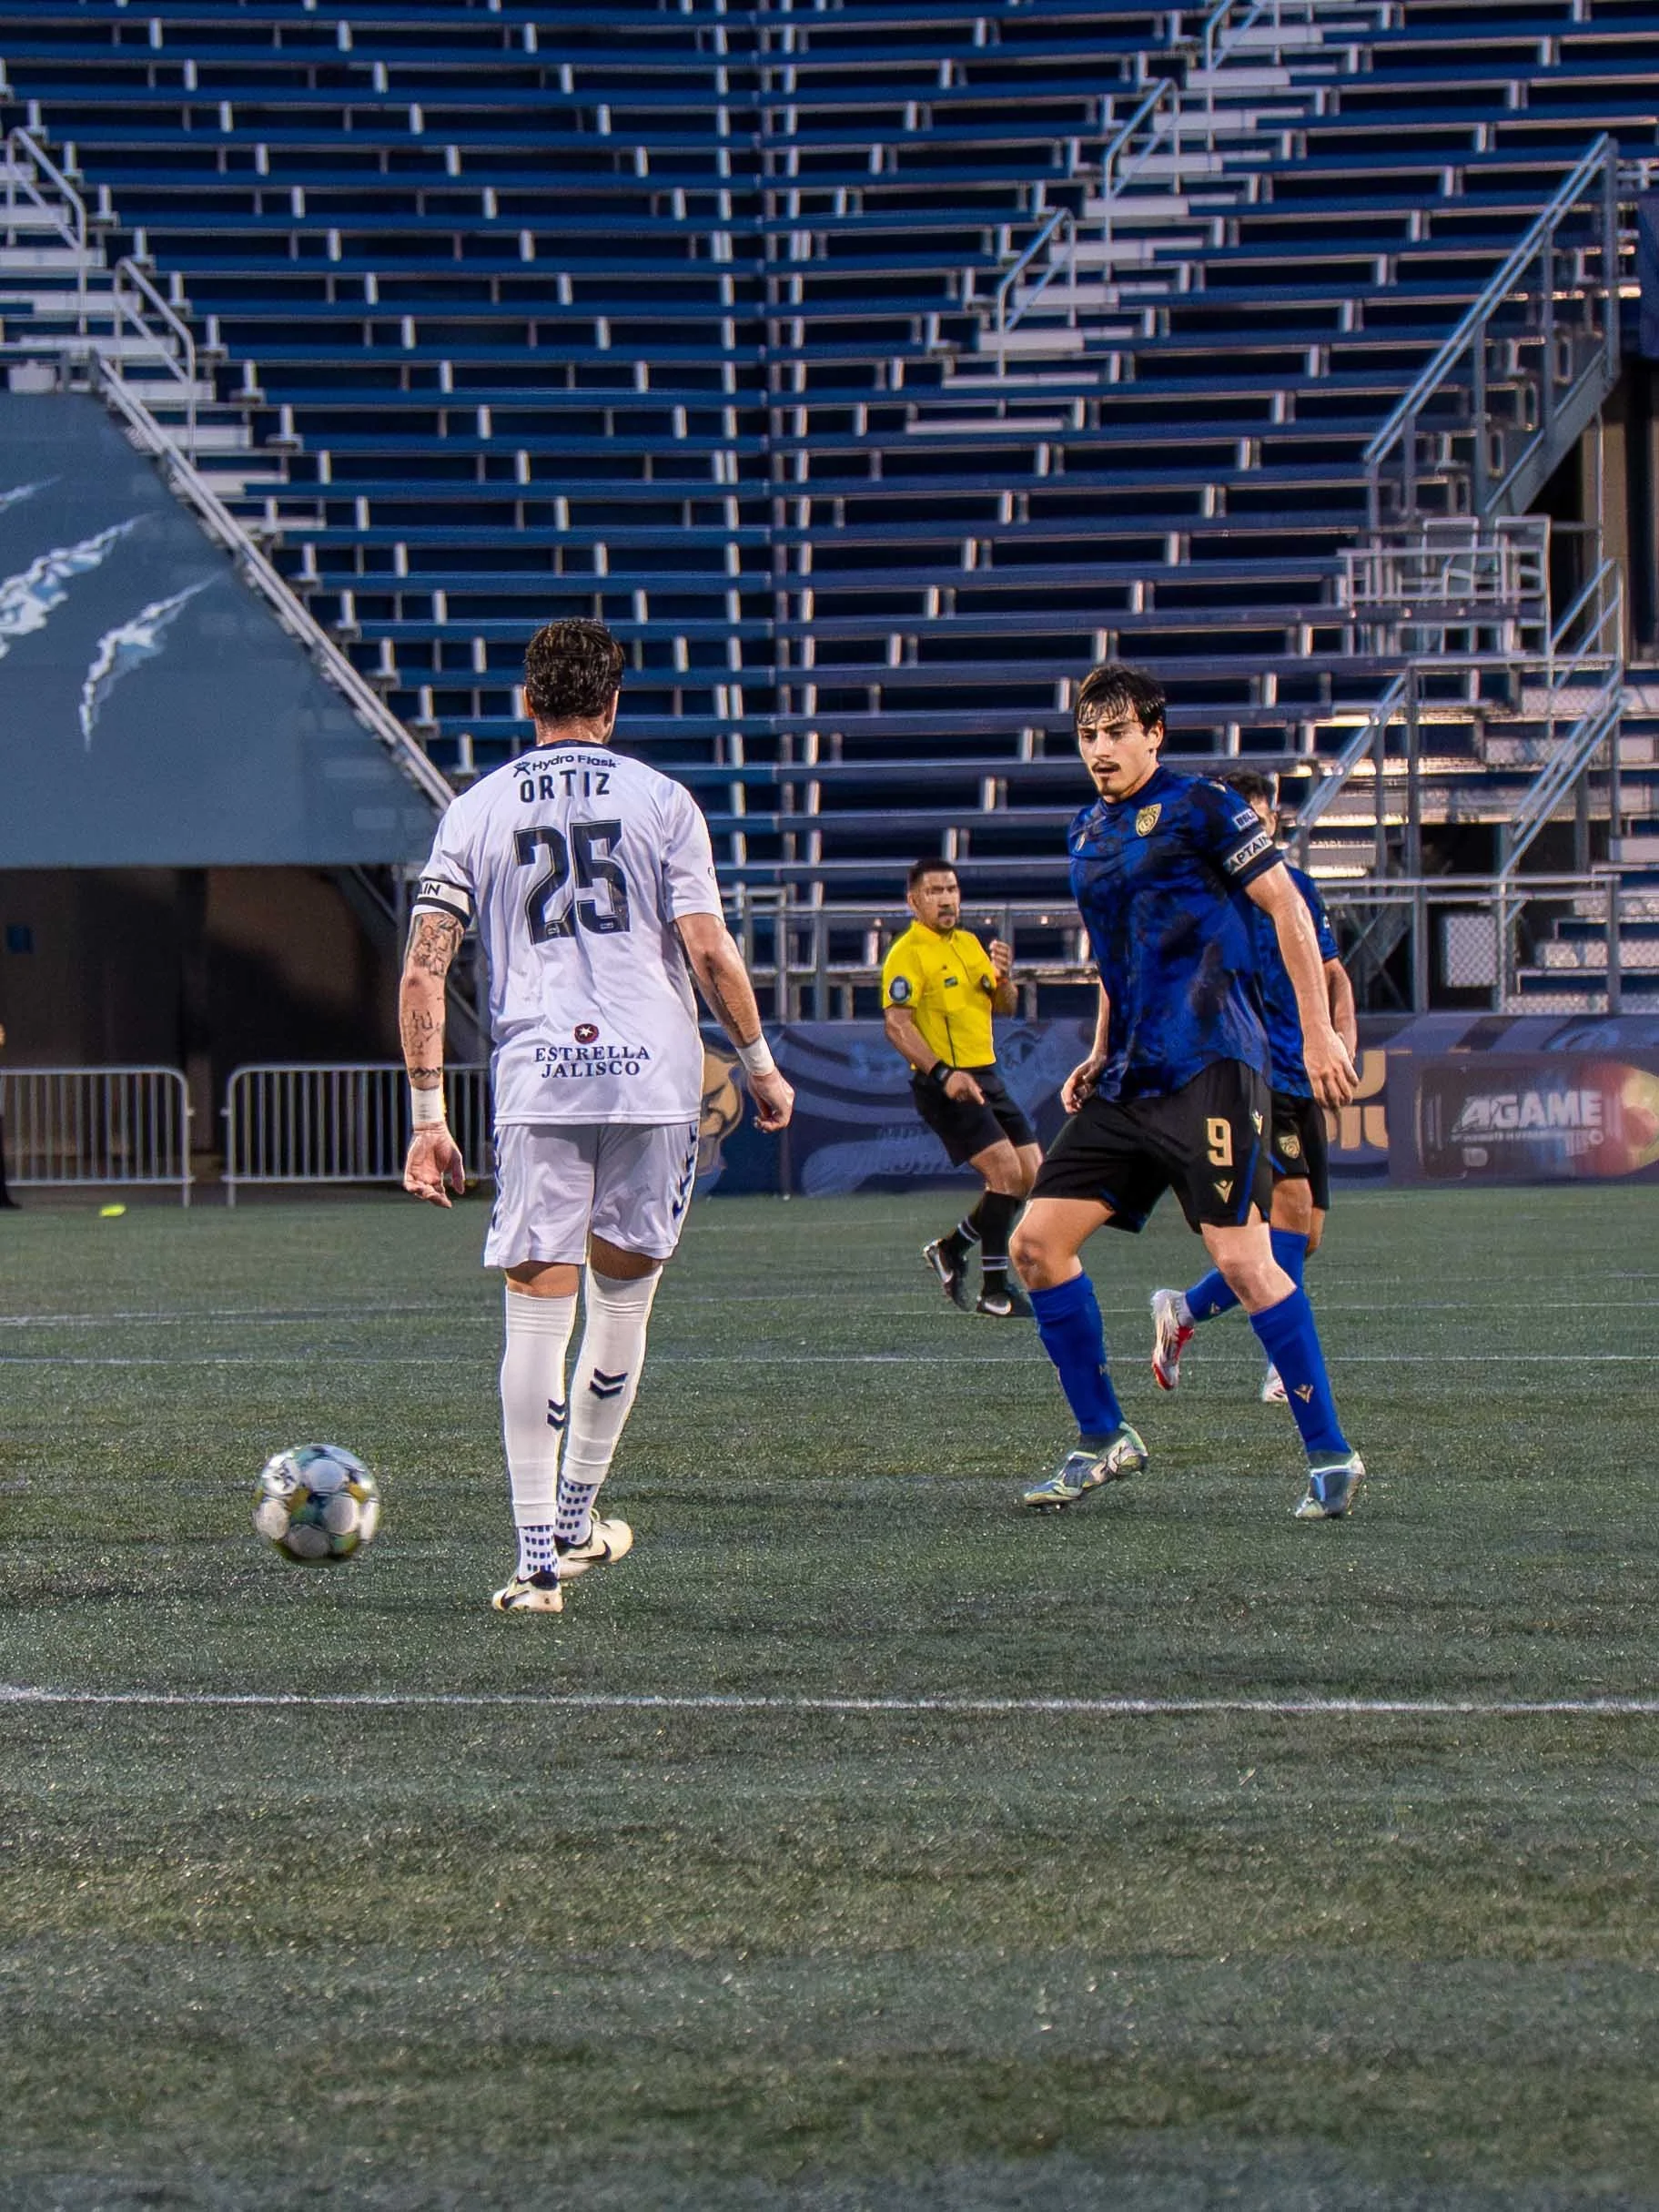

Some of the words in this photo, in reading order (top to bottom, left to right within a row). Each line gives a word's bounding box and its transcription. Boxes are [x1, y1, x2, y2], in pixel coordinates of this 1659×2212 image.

[531, 755, 574, 771] Hydro
[577, 755, 617, 768] Flask
[520, 769, 610, 803] ORTIZ
[1229, 836, 1269, 874] APTAI
[513, 819, 631, 946] 25
[535, 1046, 651, 1062] ESTRELLA
[541, 1060, 641, 1079] JALISCO
[1207, 1118, 1233, 1166] 9
